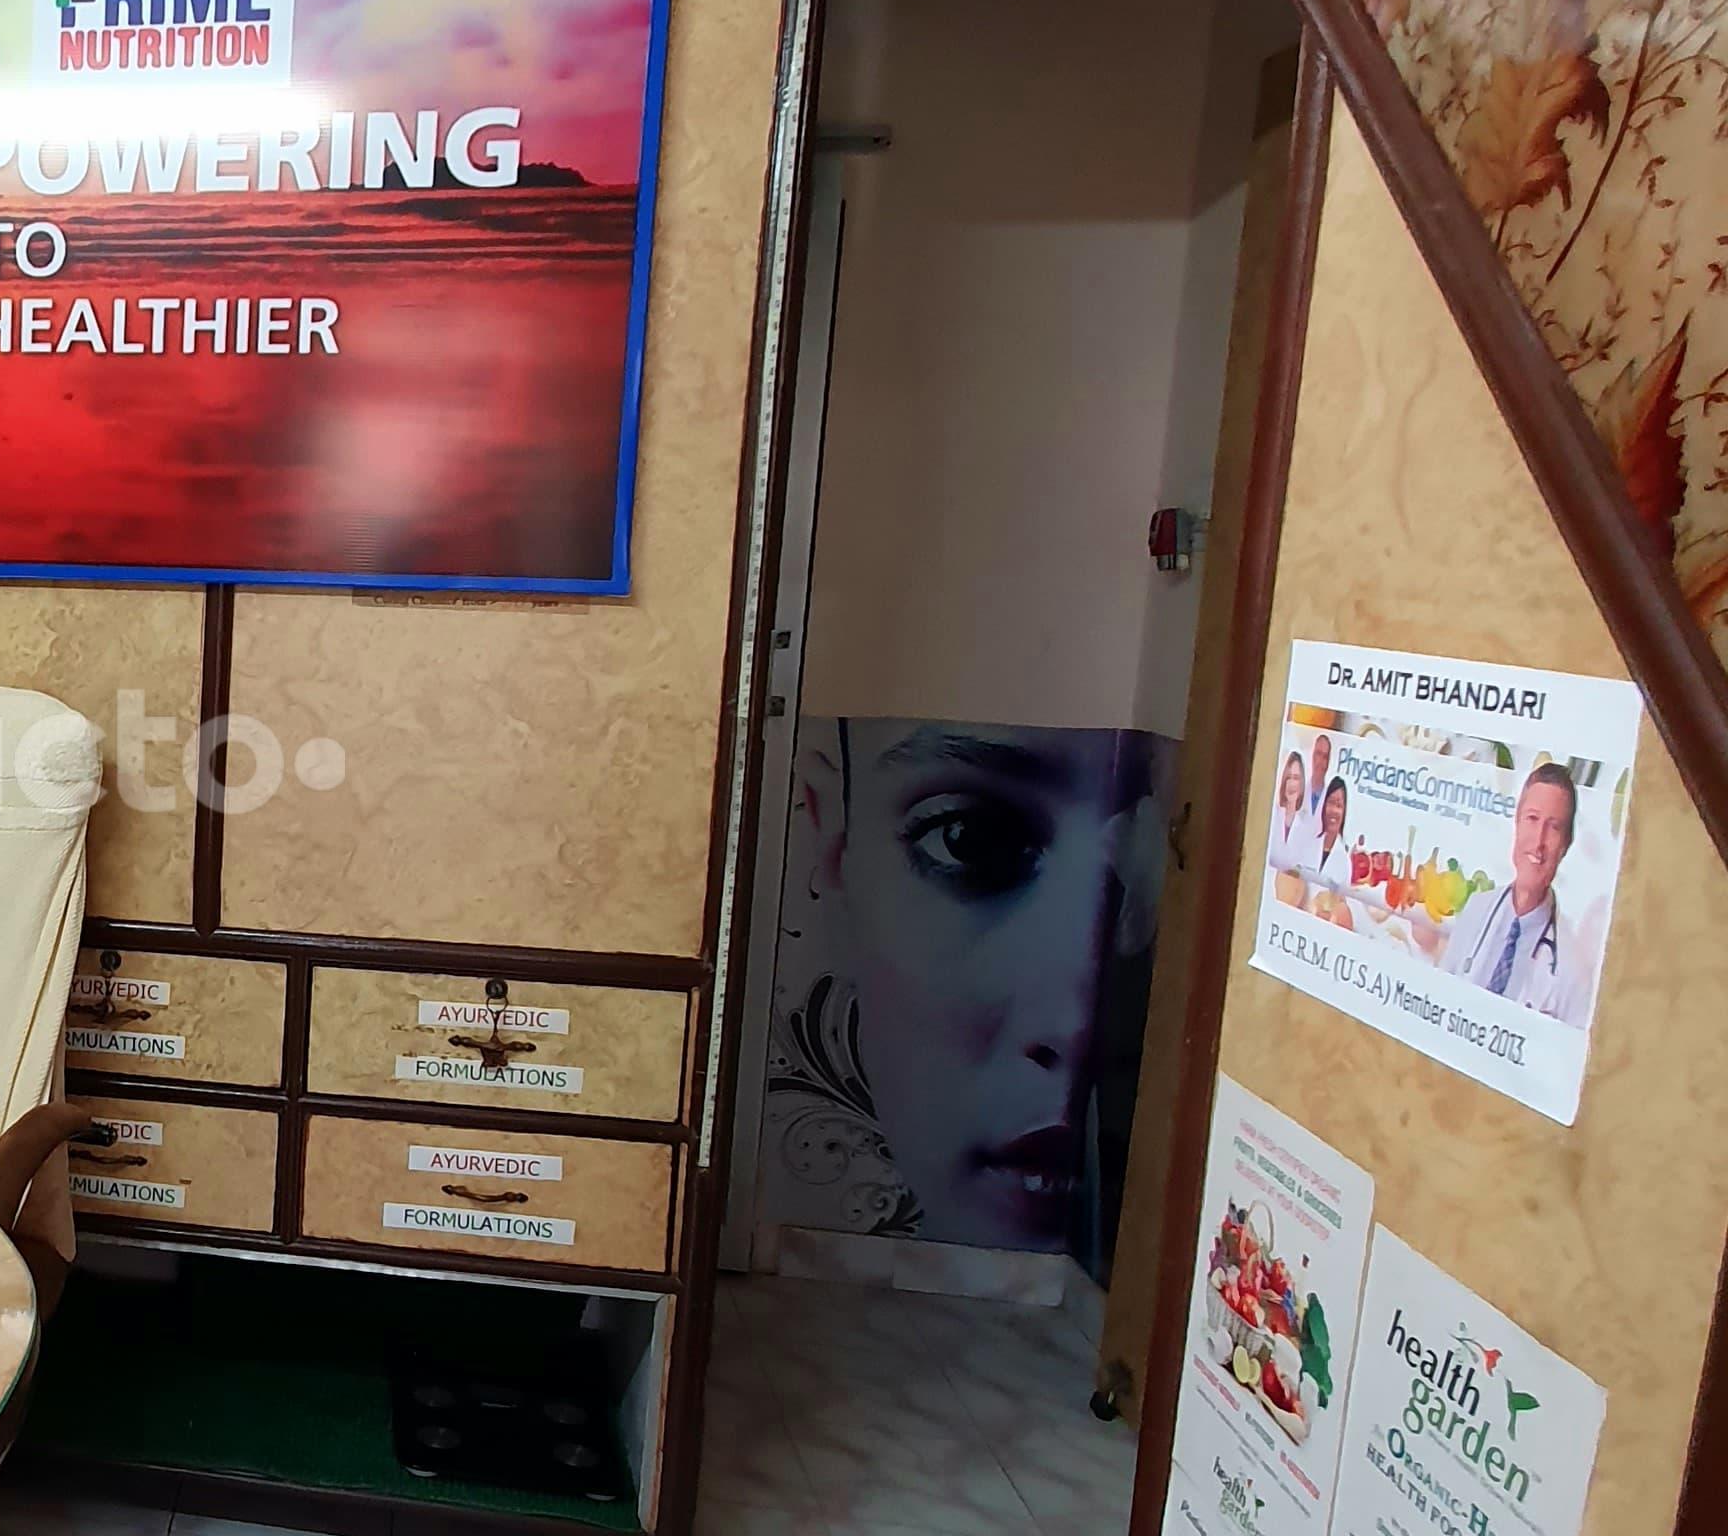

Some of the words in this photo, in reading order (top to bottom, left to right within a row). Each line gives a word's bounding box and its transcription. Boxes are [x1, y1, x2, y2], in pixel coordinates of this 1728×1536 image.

[58, 26, 270, 72] NUTRITION
[1359, 669, 1413, 701] AMIT
[1415, 675, 1547, 721] BHANDARI
[1336, 747, 1517, 819] PhysiciansCommittee
[71, 980, 160, 1001] YURVEDIC
[1333, 953, 1391, 1006] (U.S.A)
[1393, 981, 1446, 1030] Member
[1446, 1007, 1487, 1049] since
[438, 1005, 550, 1028] AYURVEDIC
[65, 1031, 176, 1055] RMULATIONS
[416, 1060, 567, 1088] FORMULATIONS
[430, 1153, 541, 1176] AYURVEDIC
[71, 1177, 176, 1204] MULATIONS
[403, 1208, 553, 1238] FORMULATIONS
[1387, 1309, 1480, 1416] health
[1402, 1377, 1530, 1504] garden
[1213, 1456, 1246, 1508] health
[1365, 1442, 1427, 1514] HEALTH
